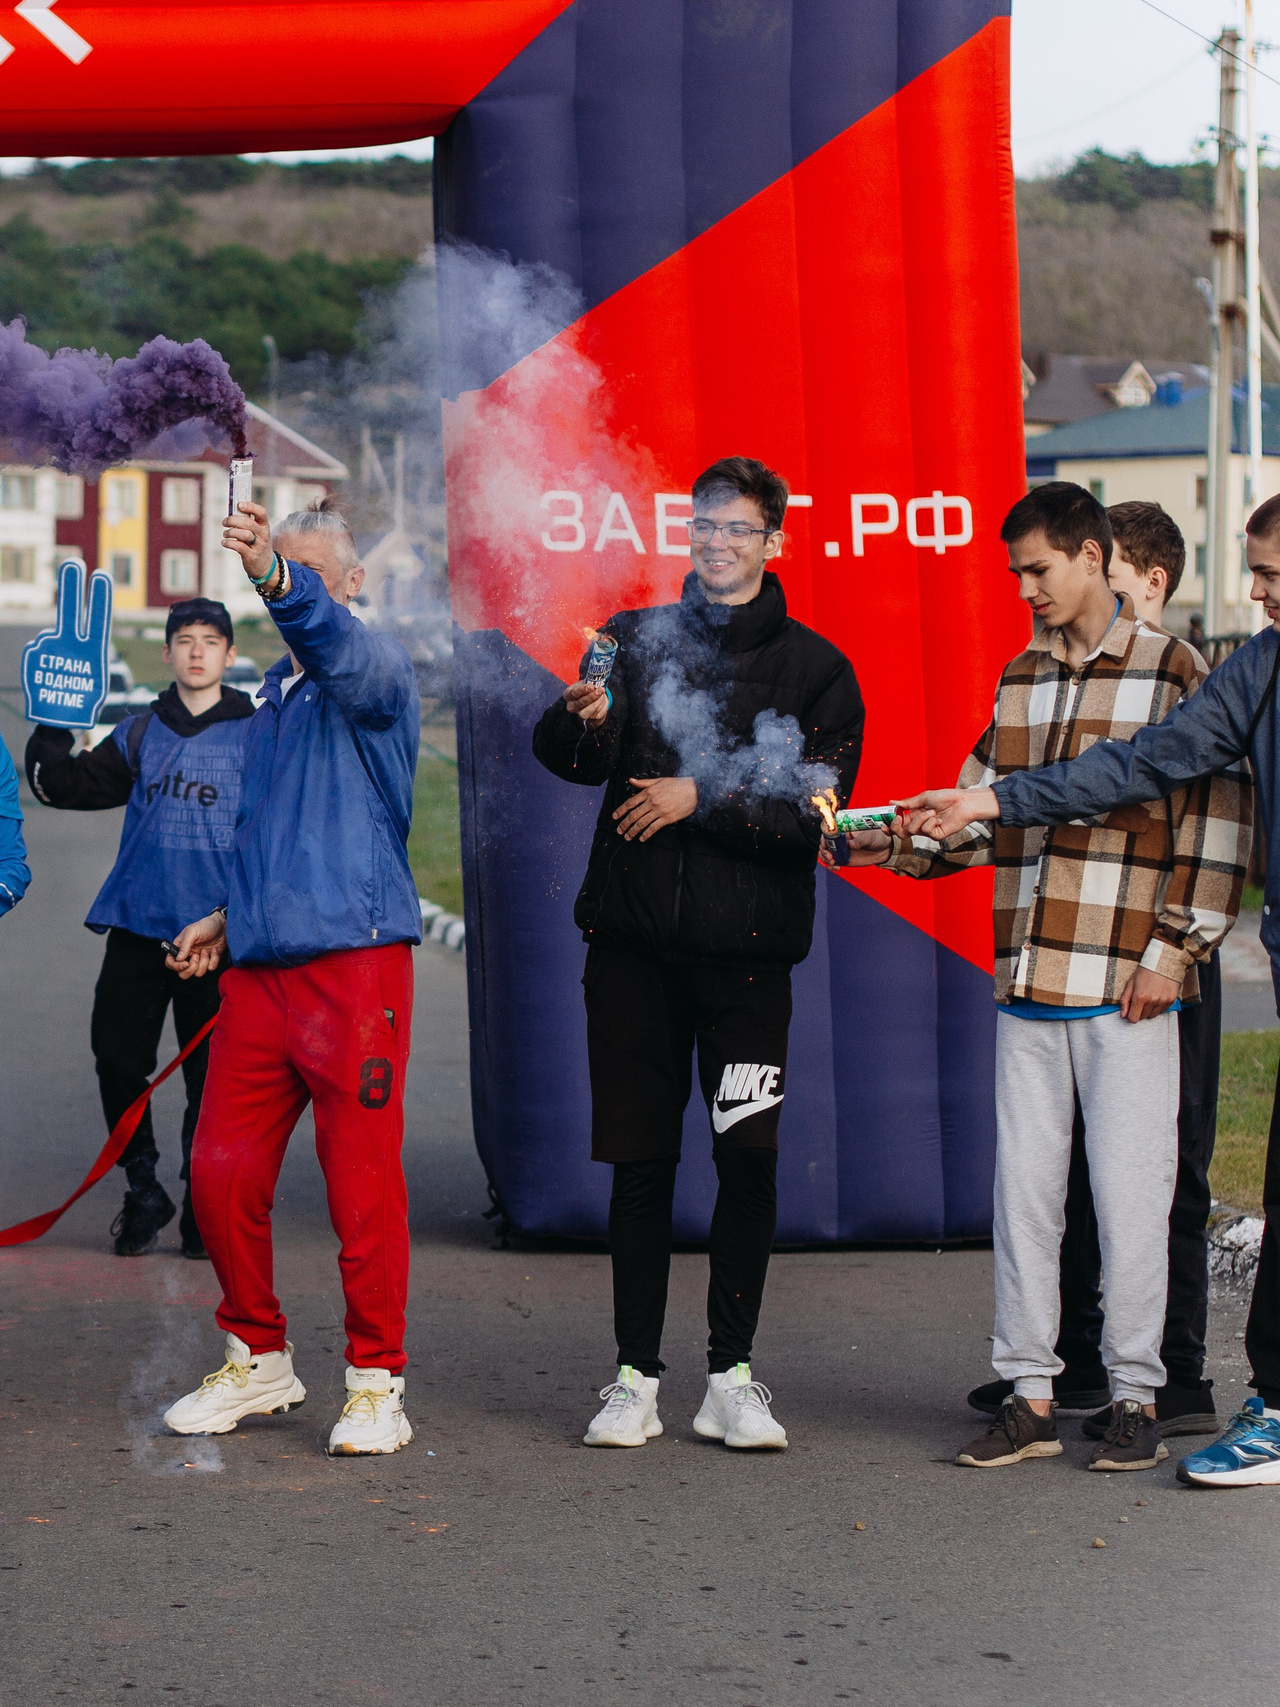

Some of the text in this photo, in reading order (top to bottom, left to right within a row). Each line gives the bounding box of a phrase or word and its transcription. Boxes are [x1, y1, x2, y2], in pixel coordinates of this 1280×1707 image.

[539, 490, 973, 557] ЗАБГ.РФ
[39, 654, 92, 675] СТРАНА
[34, 670, 94, 692] В ОДНОМ
[39, 688, 84, 709] РИТМЕ
[358, 1057, 394, 1110] 8
[717, 1063, 781, 1101] NIKE
